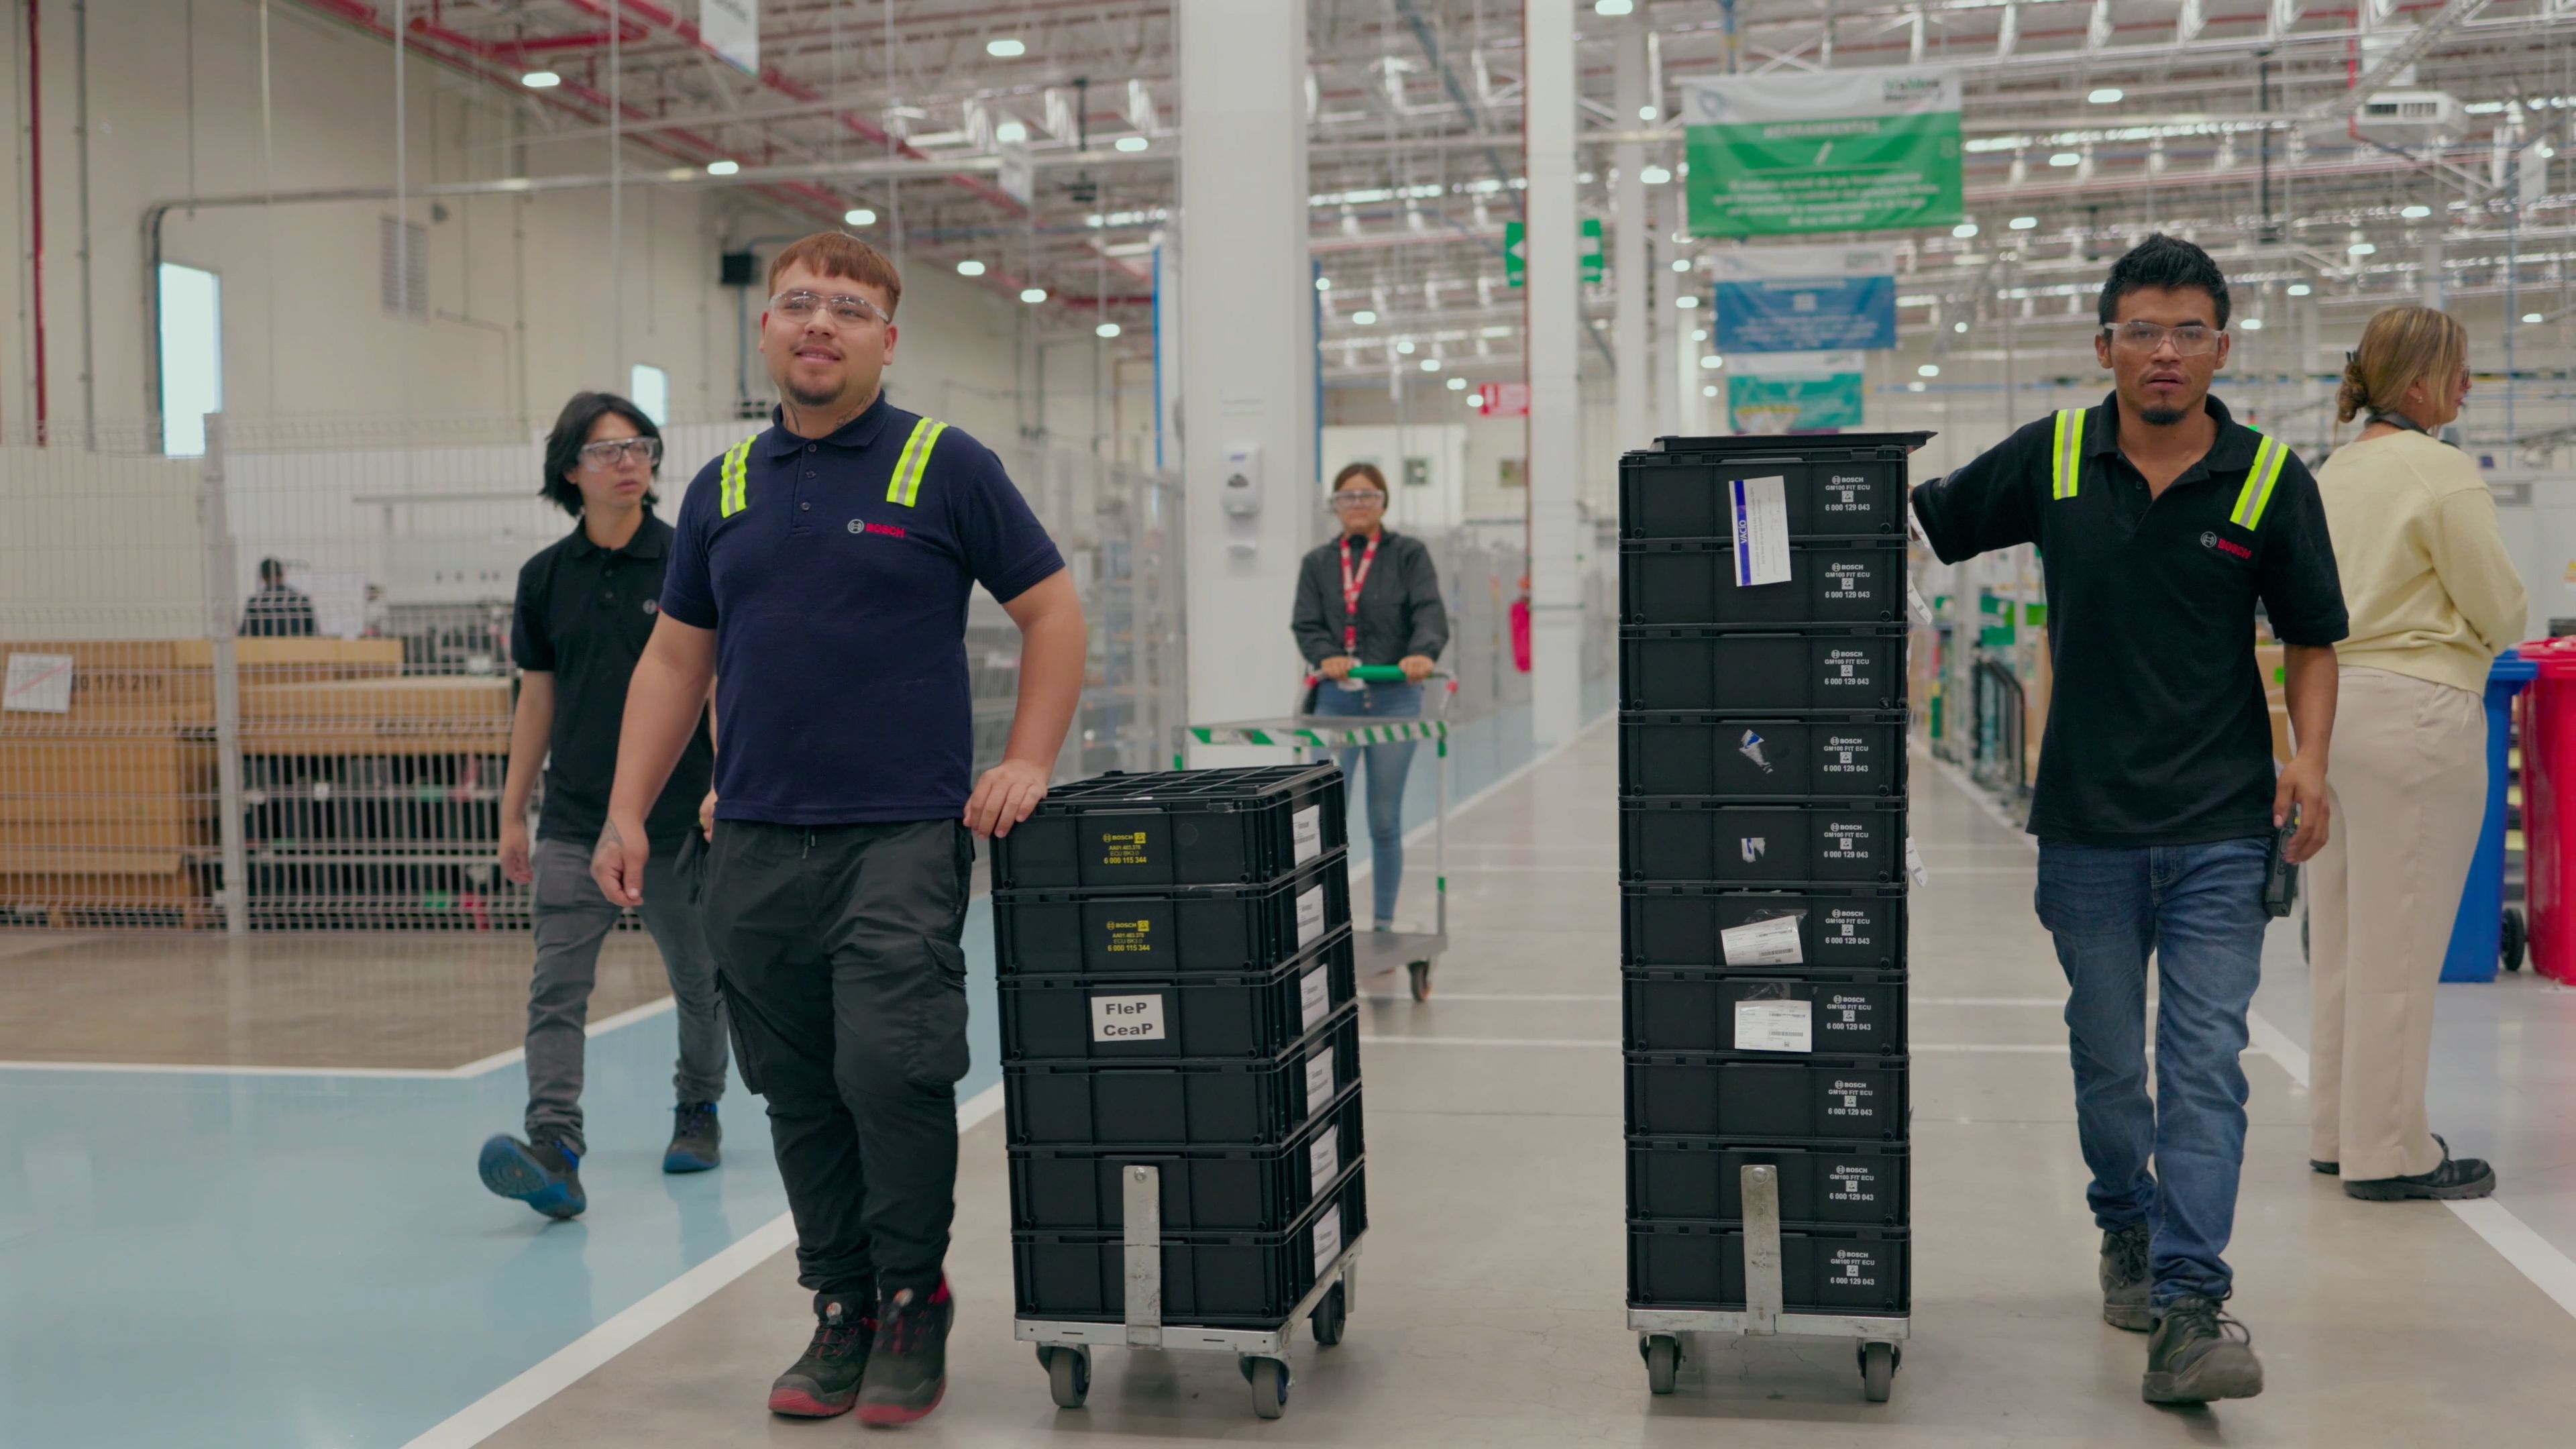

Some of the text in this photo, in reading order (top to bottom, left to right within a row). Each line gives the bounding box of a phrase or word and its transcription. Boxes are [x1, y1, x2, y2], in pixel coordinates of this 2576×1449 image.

[866, 523, 906, 538] BOSCH
[2218, 538, 2253, 559] BOSCH
[1104, 1023, 1153, 1036] CeaP
